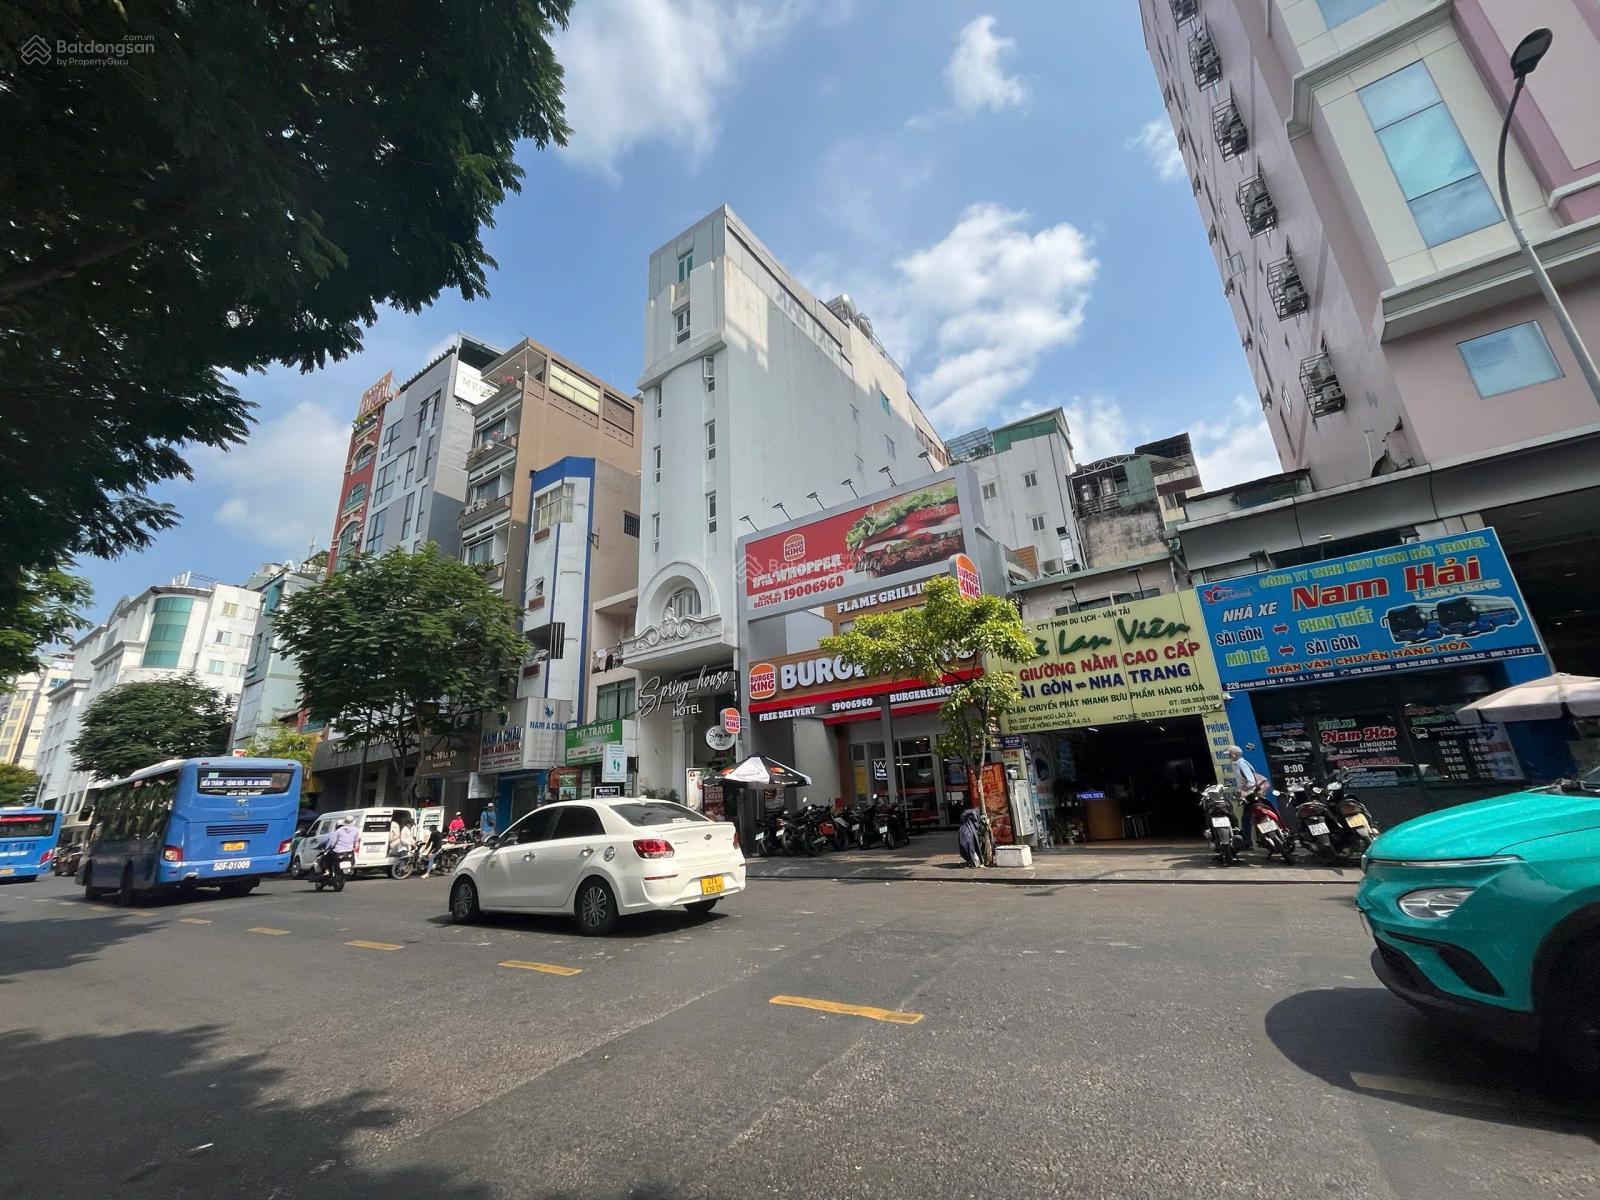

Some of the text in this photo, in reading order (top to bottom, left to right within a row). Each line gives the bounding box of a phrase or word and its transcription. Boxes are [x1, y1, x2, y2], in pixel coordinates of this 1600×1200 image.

[785, 541, 804, 551] BURGER
[785, 545, 804, 557] KING
[773, 553, 842, 582] WHOPPER
[1259, 536, 1490, 588] CÔNG TY TNHH MTV NAM HẢI TRAVEL
[957, 566, 980, 585] BURGER
[1291, 555, 1482, 612] Nam Hải
[784, 575, 845, 600] 19006960
[959, 577, 982, 598] KING
[754, 597, 782, 608] DELIVERY
[837, 582, 925, 613] FLAME GRILLI
[1036, 623, 1049, 631] CTY
[1050, 619, 1068, 628] TNHH
[1080, 614, 1097, 623] LỊCH
[1102, 609, 1117, 619] VẬN
[1118, 605, 1131, 615] TẢI
[1223, 602, 1278, 622] NHÀ XE
[1215, 606, 1374, 646] SÀI GÒN PHAN THIẾT
[1059, 629, 1112, 655] Lan
[1116, 617, 1191, 645] Viên
[1251, 646, 1270, 663] NÉ
[1305, 638, 1328, 655] SÀI
[1330, 634, 1361, 652] GÒN
[1019, 661, 1077, 682] GIƯỜNG
[1123, 648, 1158, 666] CAO
[1163, 638, 1200, 659] CẤP
[1304, 657, 1333, 672] VẬN
[1335, 650, 1390, 666] CHUYỂN
[1391, 645, 1434, 659] HÀNG
[750, 673, 775, 684] BURGER
[750, 680, 775, 692] KING
[1016, 663, 1191, 699] ÀI GÒN NHA TRANG
[1226, 682, 1240, 690] 229
[640, 665, 729, 717] Spring house
[1029, 699, 1058, 713] CHUYỂN
[1060, 698, 1079, 709] PHÁT
[1082, 695, 1108, 706] NHANH
[1111, 692, 1128, 702] BƯU
[1130, 687, 1155, 700] PHẨM
[1158, 685, 1183, 696] HÀNG
[1185, 682, 1205, 692] HÓA
[673, 705, 702, 717] HOTEL
[759, 706, 816, 721] FREE DELIVERY
[832, 698, 873, 711] 19006960
[530, 721, 545, 729] NAM
[576, 723, 614, 739] HT TRAVEL
[725, 720, 740, 729] KING
[1206, 721, 1230, 733] PHÒNG
[483, 732, 497, 746] NAM
[1321, 726, 1397, 745] Nam Hải
[1359, 740, 1397, 748] LIMOUSINE
[1283, 764, 1304, 773] 9:00
